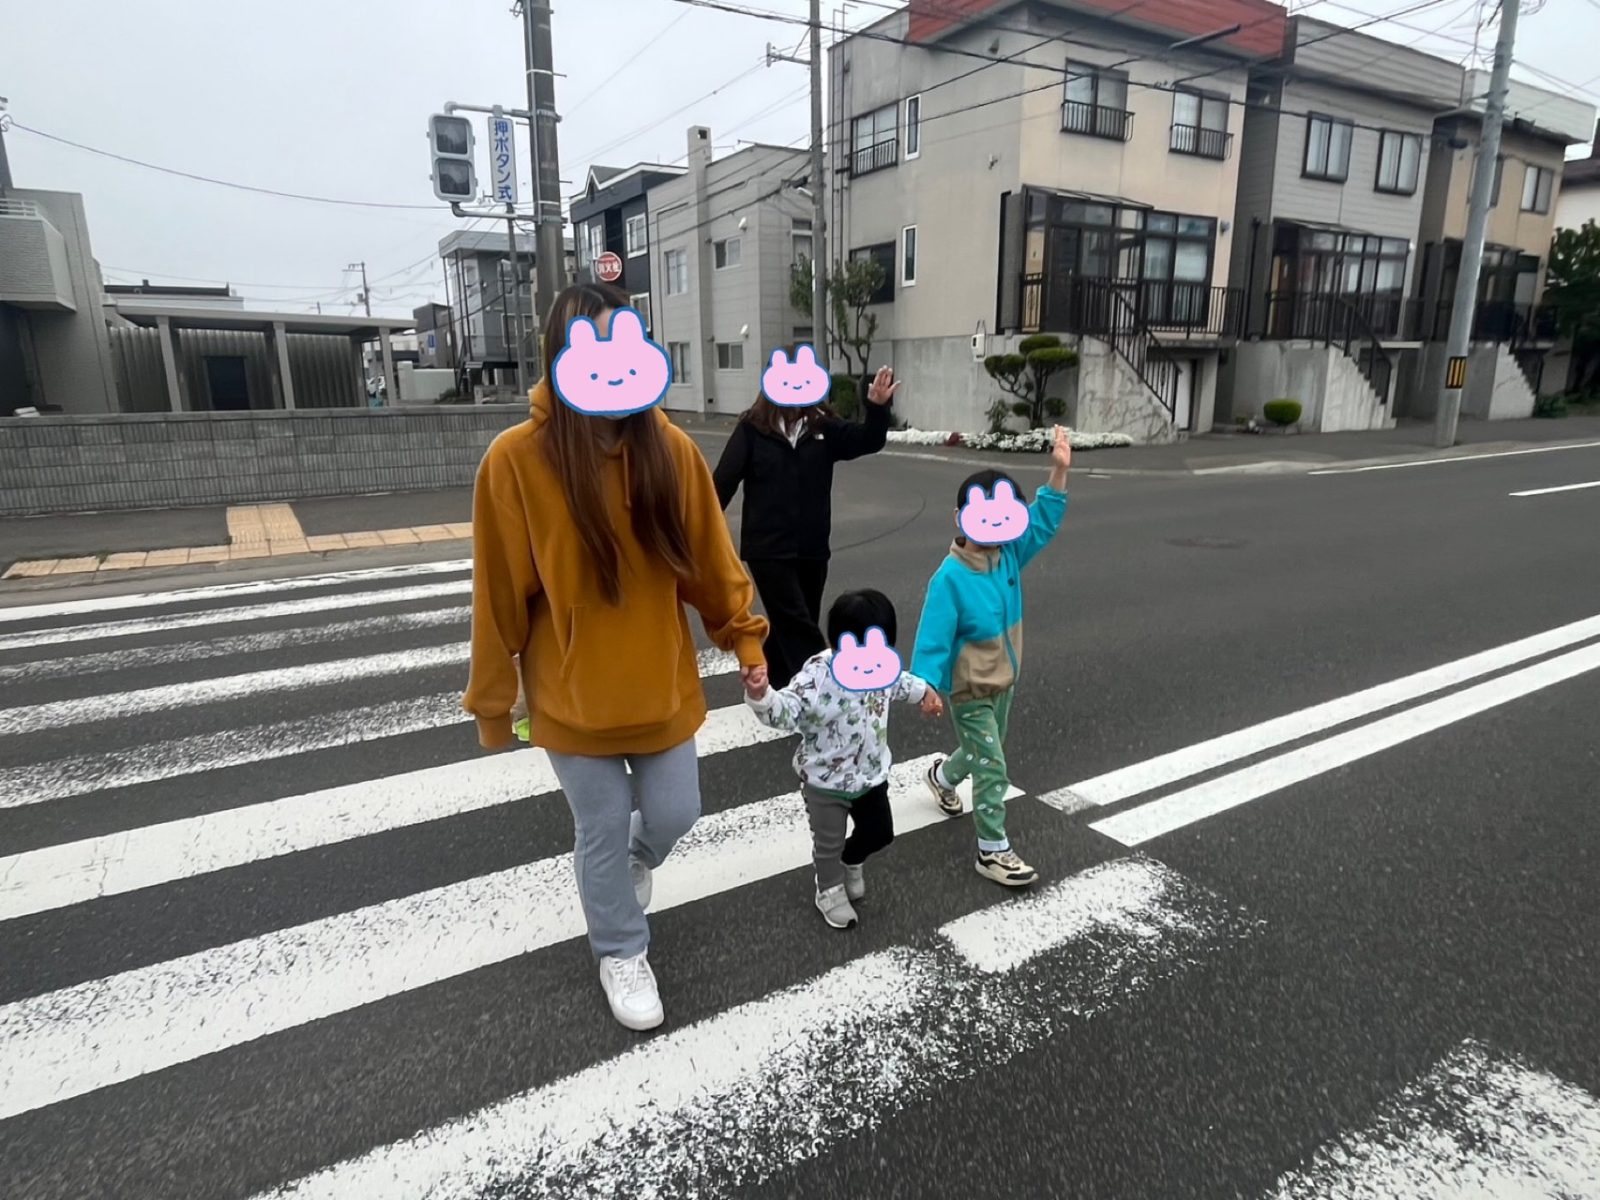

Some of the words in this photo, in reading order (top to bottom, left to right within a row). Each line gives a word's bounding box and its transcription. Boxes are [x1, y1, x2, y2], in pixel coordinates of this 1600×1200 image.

[495, 121, 512, 200] 押ボタン式
